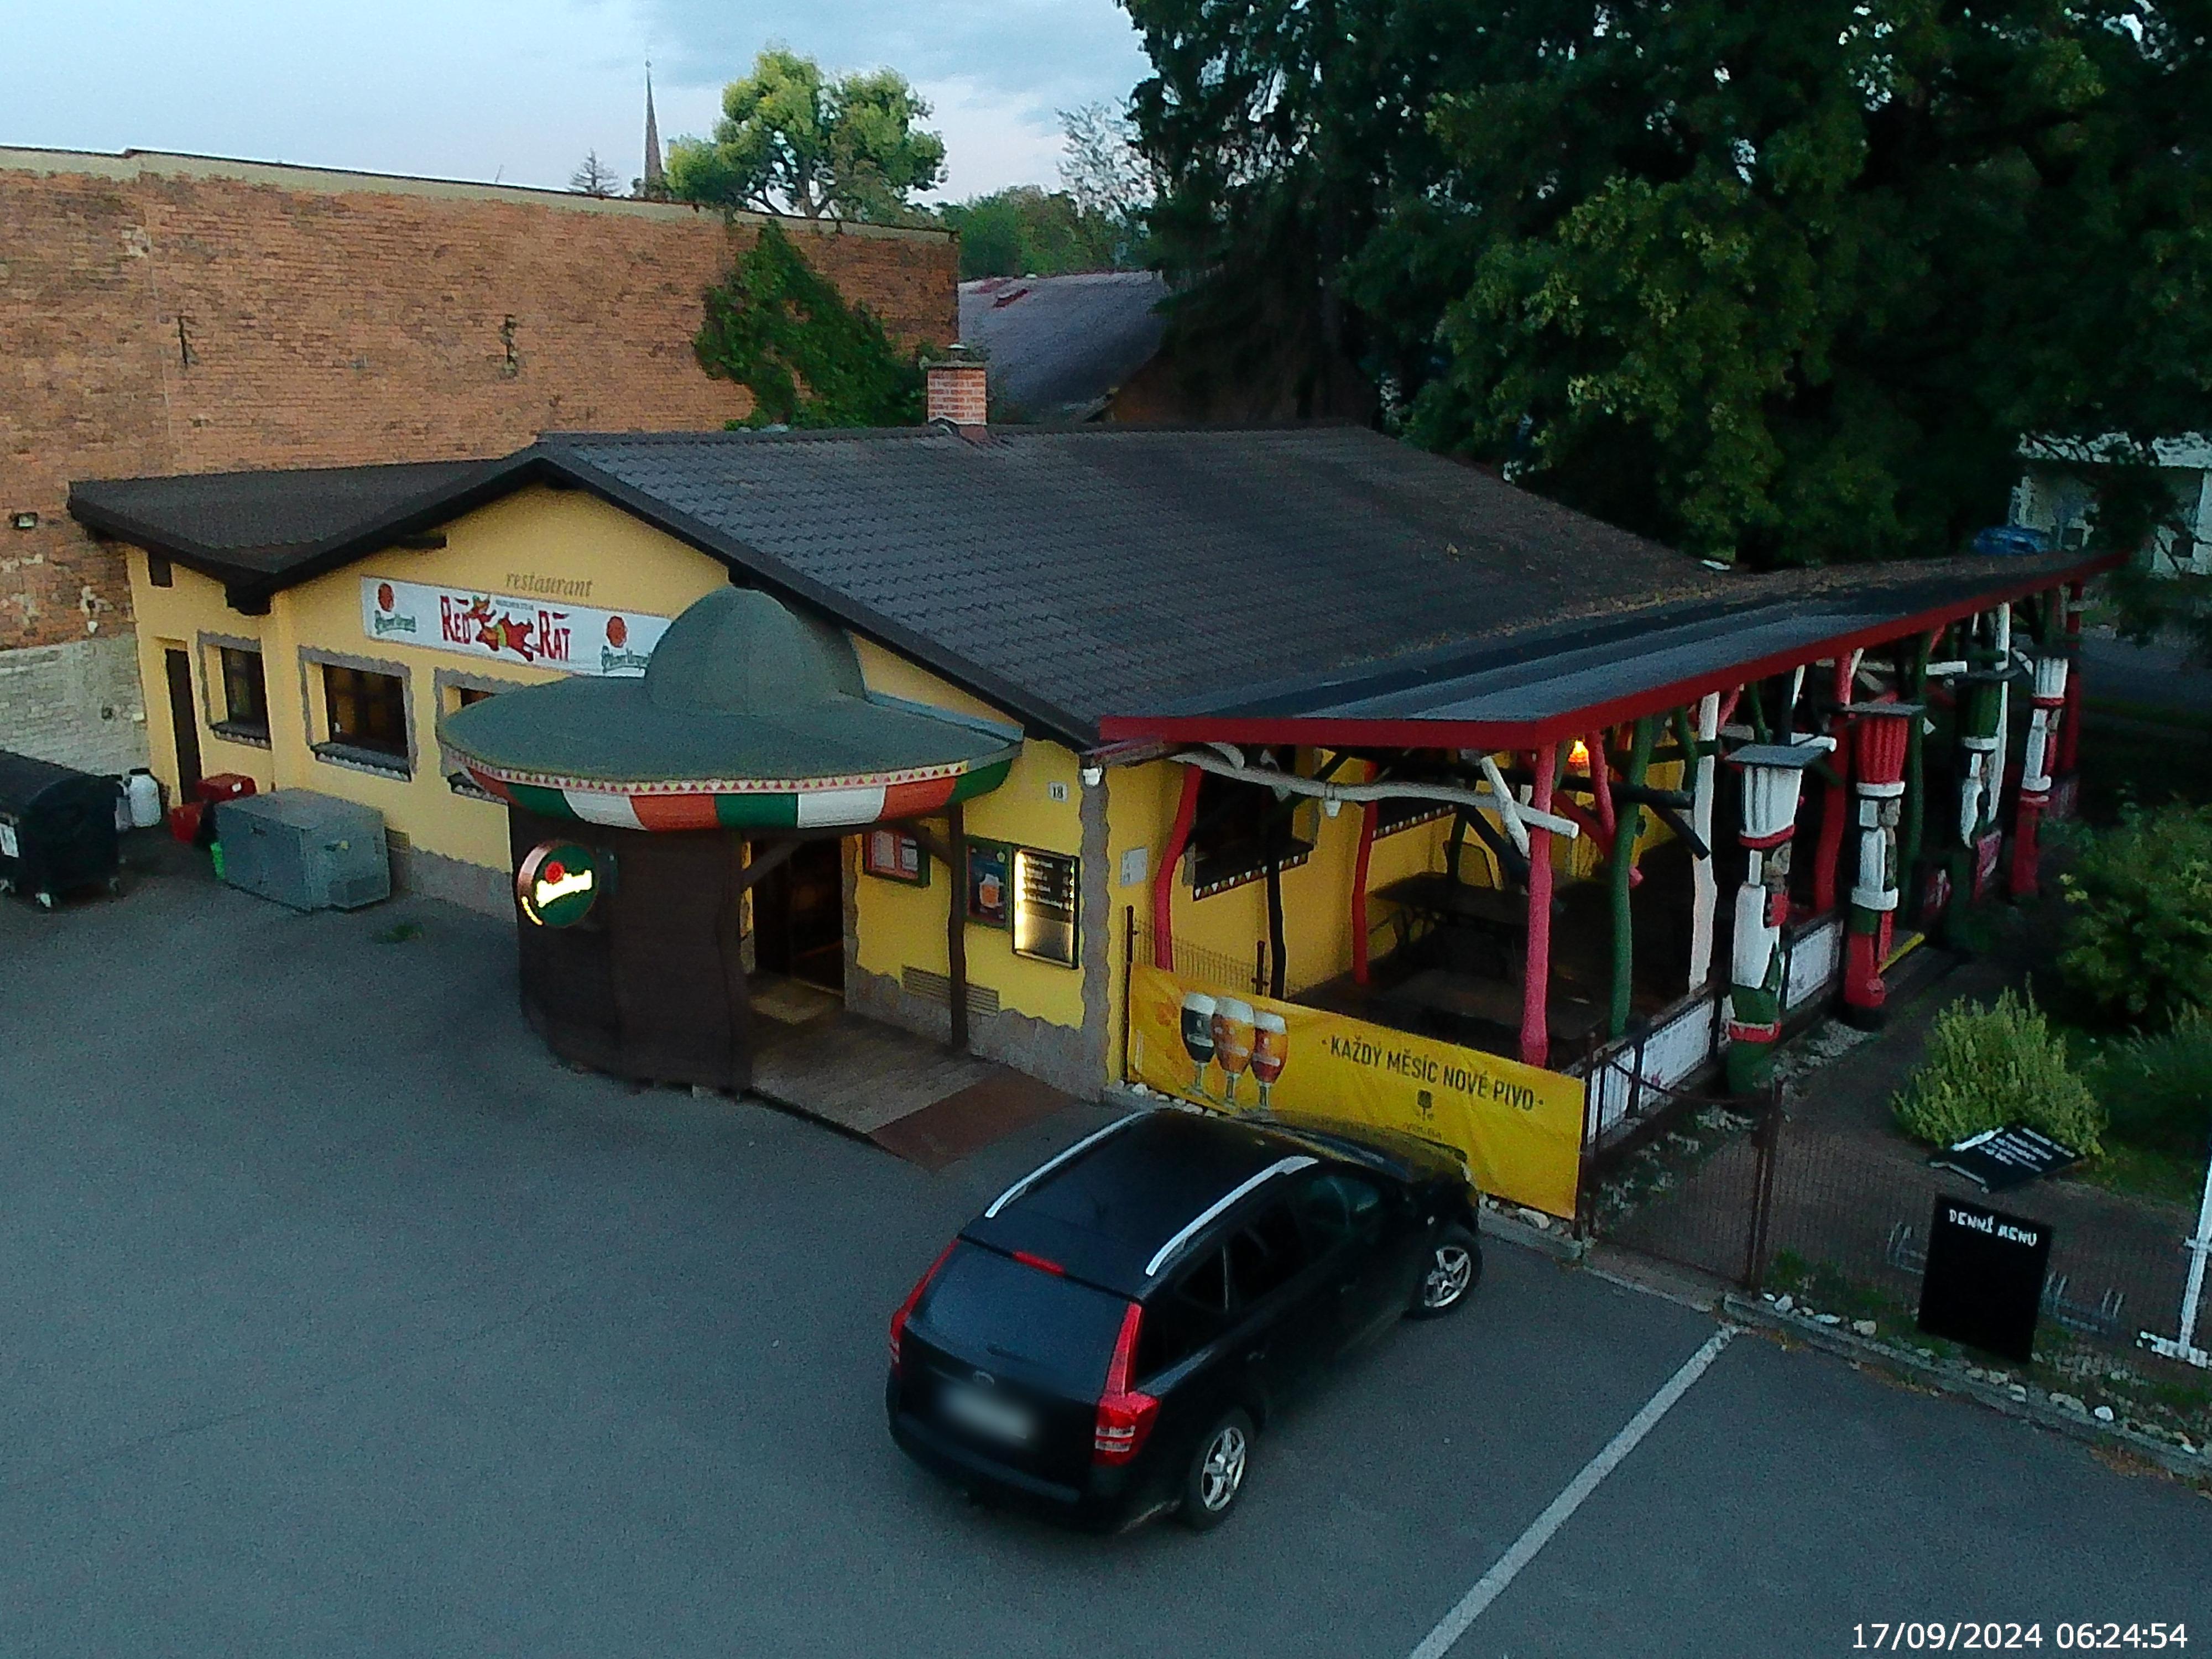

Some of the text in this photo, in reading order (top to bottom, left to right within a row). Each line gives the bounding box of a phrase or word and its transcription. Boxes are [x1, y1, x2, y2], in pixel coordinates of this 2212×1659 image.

[506, 572, 593, 598] restaurant
[440, 594, 471, 644] RED
[538, 610, 571, 661] RAT
[1053, 785, 1063, 799] 18
[1331, 1035, 1534, 1112] KAŽDÝ MĚSÍC NOVÉ PIVO
